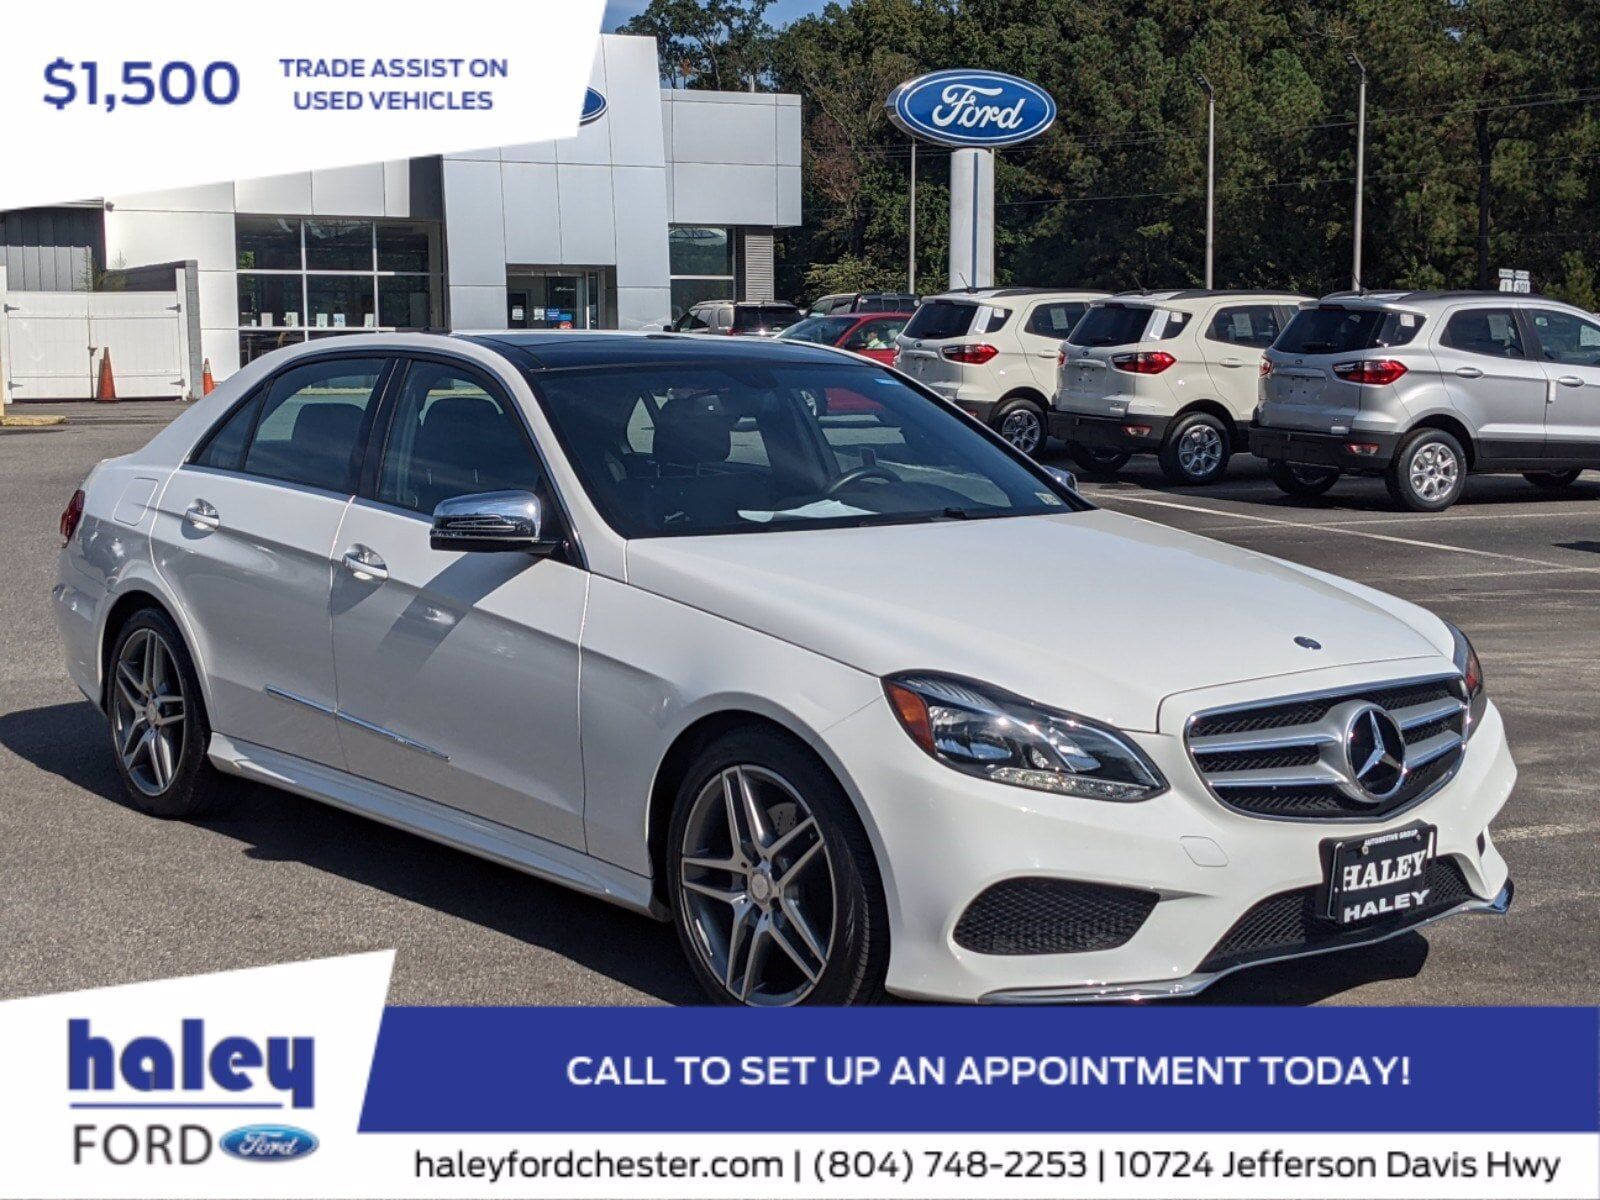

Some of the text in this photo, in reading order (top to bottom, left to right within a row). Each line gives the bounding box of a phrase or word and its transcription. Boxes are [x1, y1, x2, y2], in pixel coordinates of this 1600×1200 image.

[932, 83, 1026, 130] Ford
[1343, 849, 1427, 892] HALEY
[1343, 889, 1431, 923] HALEY
